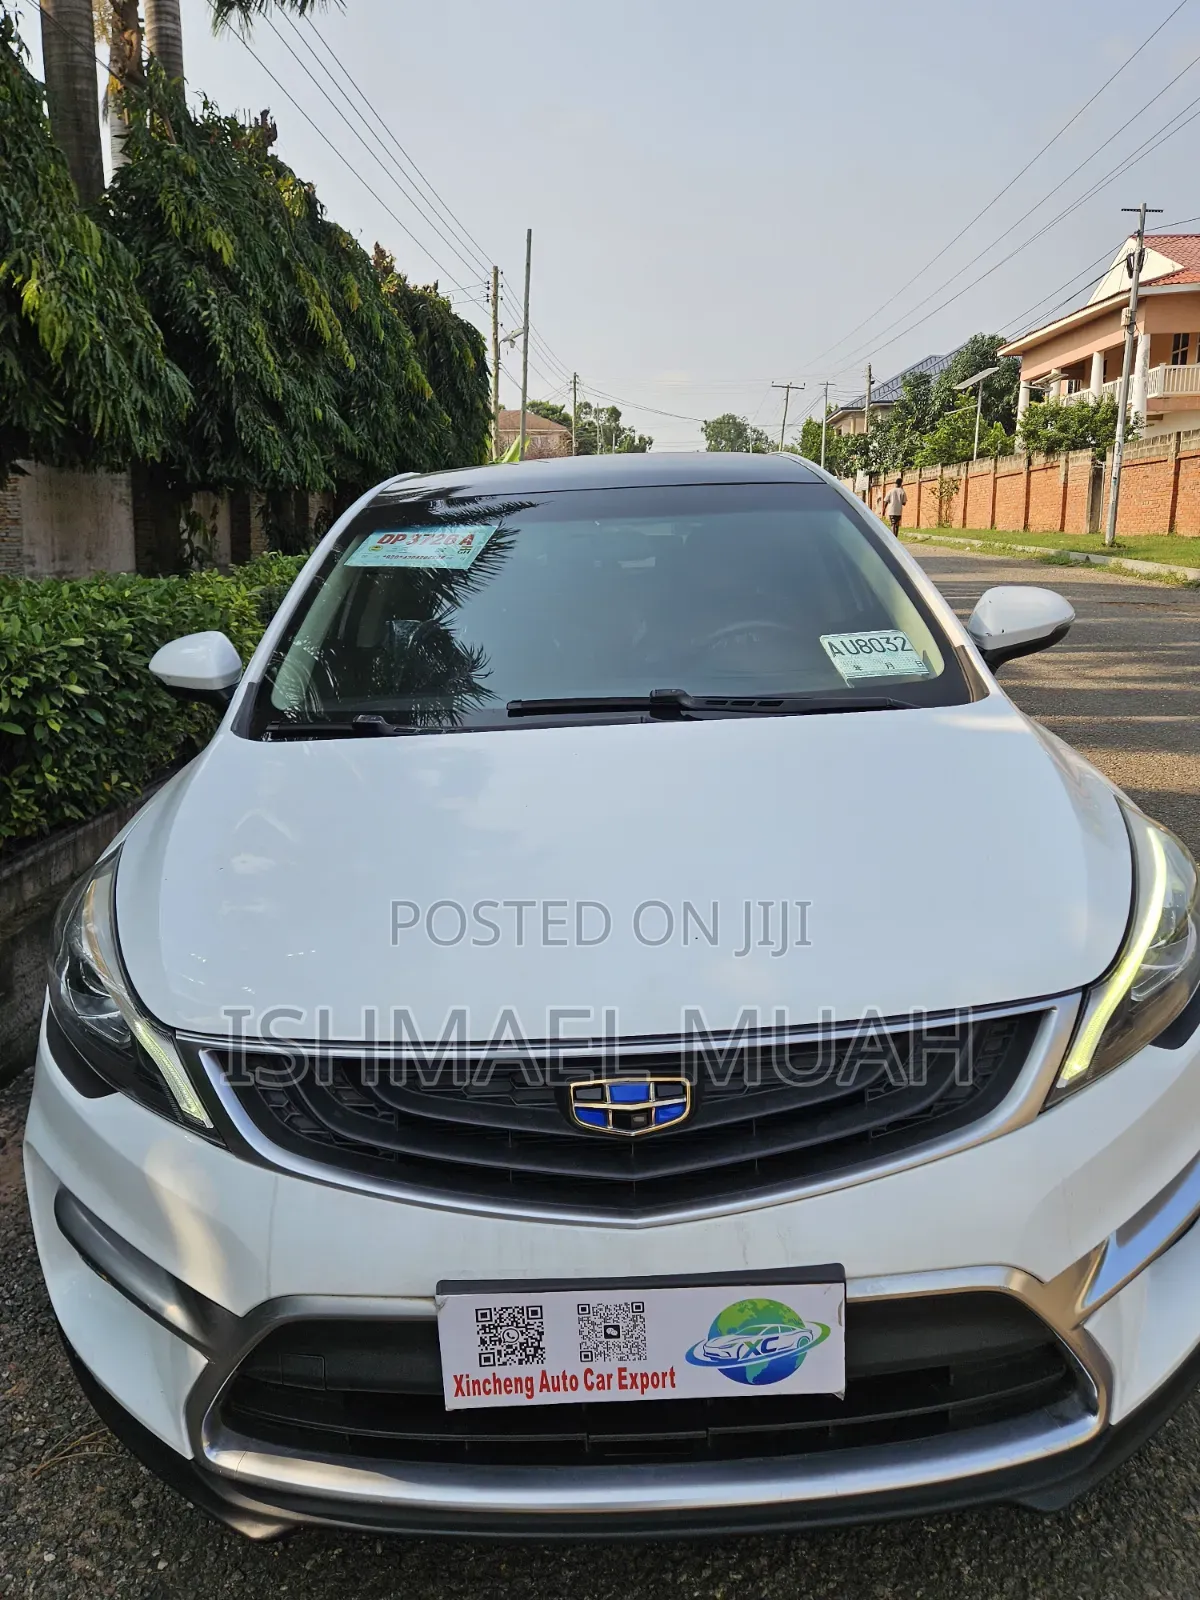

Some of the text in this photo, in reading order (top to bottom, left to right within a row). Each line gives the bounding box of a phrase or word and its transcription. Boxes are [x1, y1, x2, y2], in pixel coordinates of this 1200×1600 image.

[376, 533, 407, 544] DP
[458, 533, 475, 545] A
[828, 636, 913, 658] AU8032
[453, 1365, 676, 1400] Xincheng Auto Car Export
